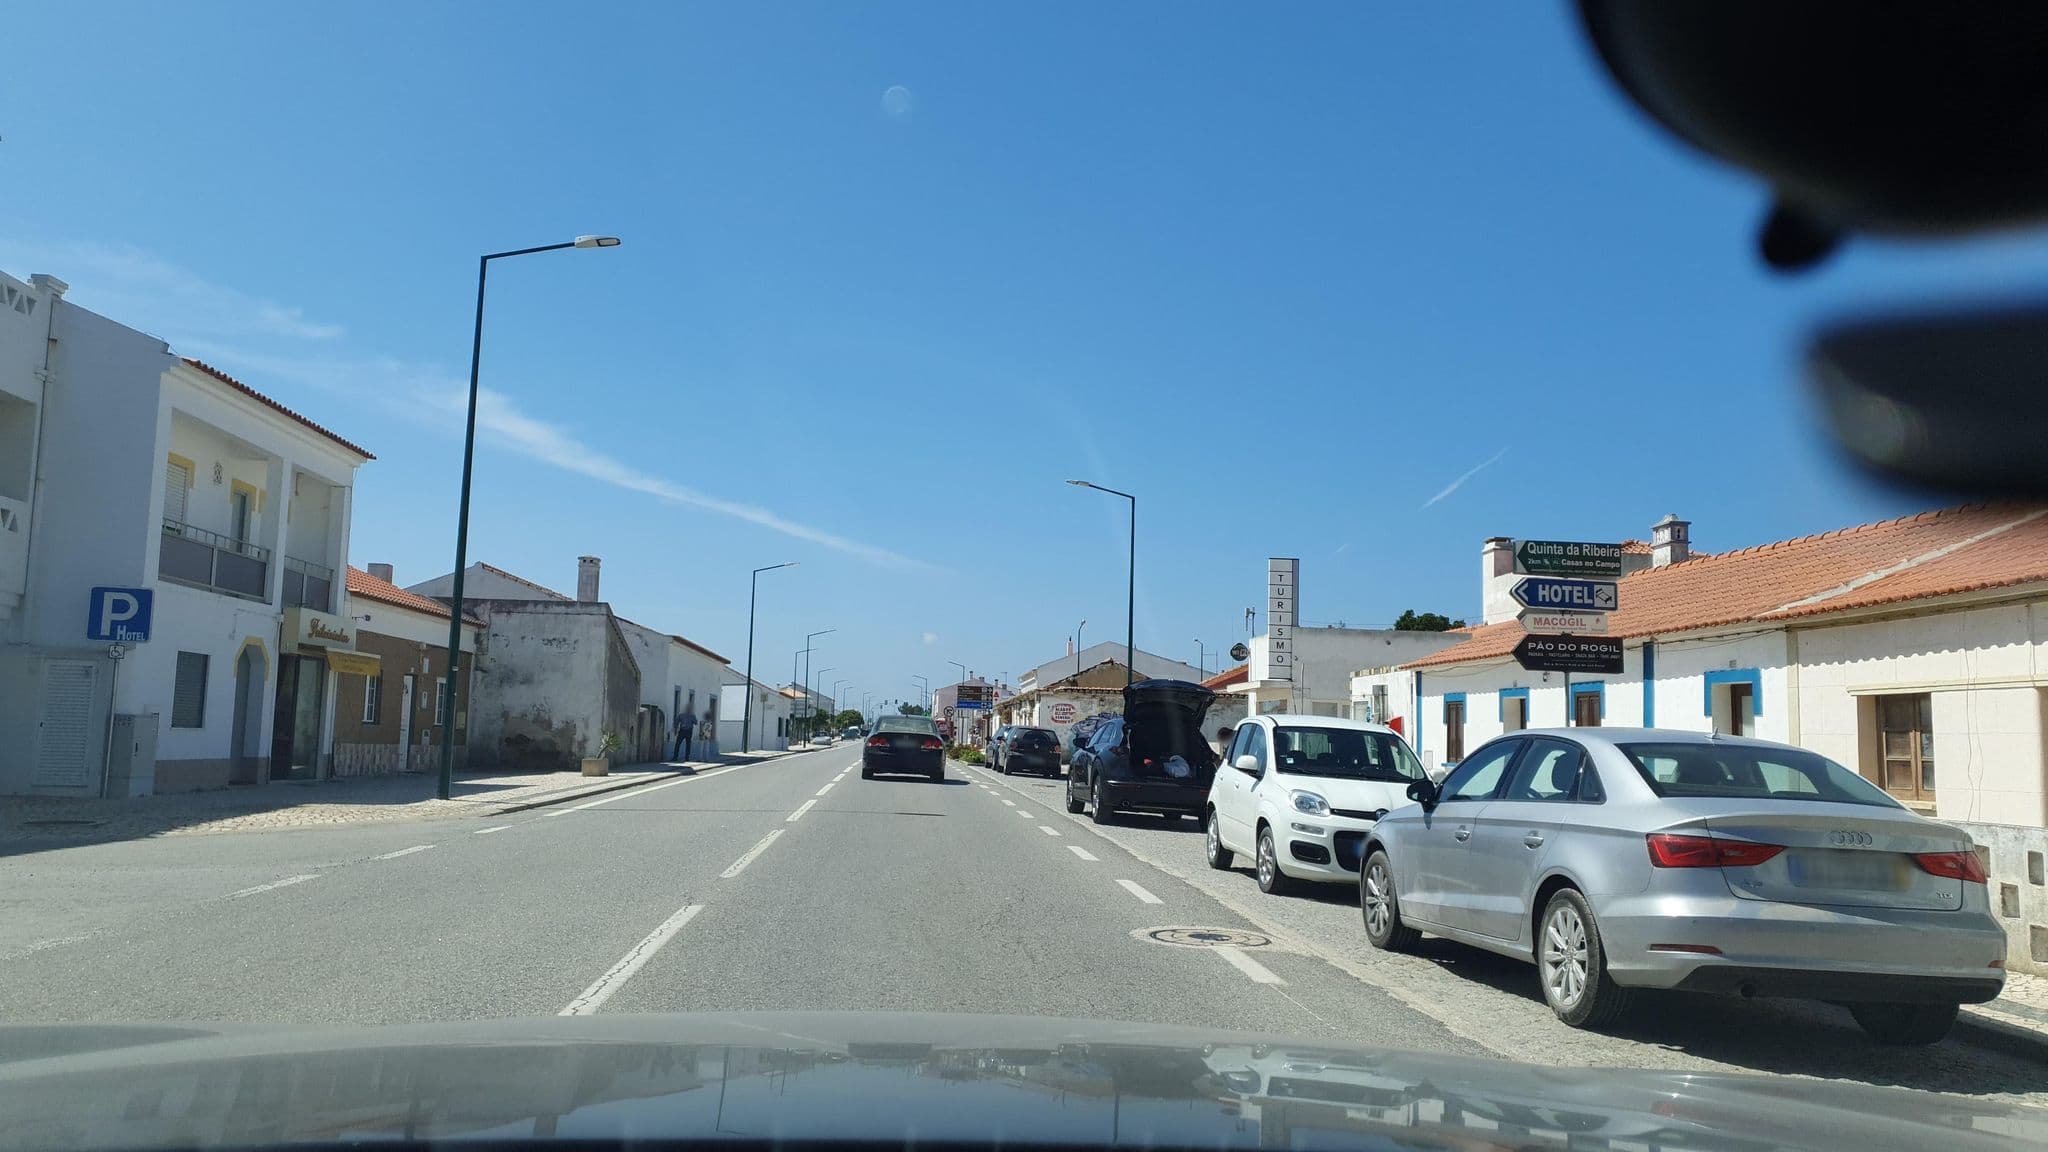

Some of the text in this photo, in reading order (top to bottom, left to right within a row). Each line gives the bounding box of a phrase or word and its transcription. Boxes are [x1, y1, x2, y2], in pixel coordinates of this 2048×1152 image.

[1527, 542, 1620, 557] Quinta da Ribeira
[1561, 559, 1583, 567] Casas
[1595, 560, 1620, 568] Campo
[1538, 584, 1593, 604] HOTEL
[101, 592, 139, 636] P
[1276, 574, 1285, 663] TURISMO
[1533, 617, 1586, 627] MACOGIL
[1528, 641, 1620, 652] PÃO DO ROGIL
